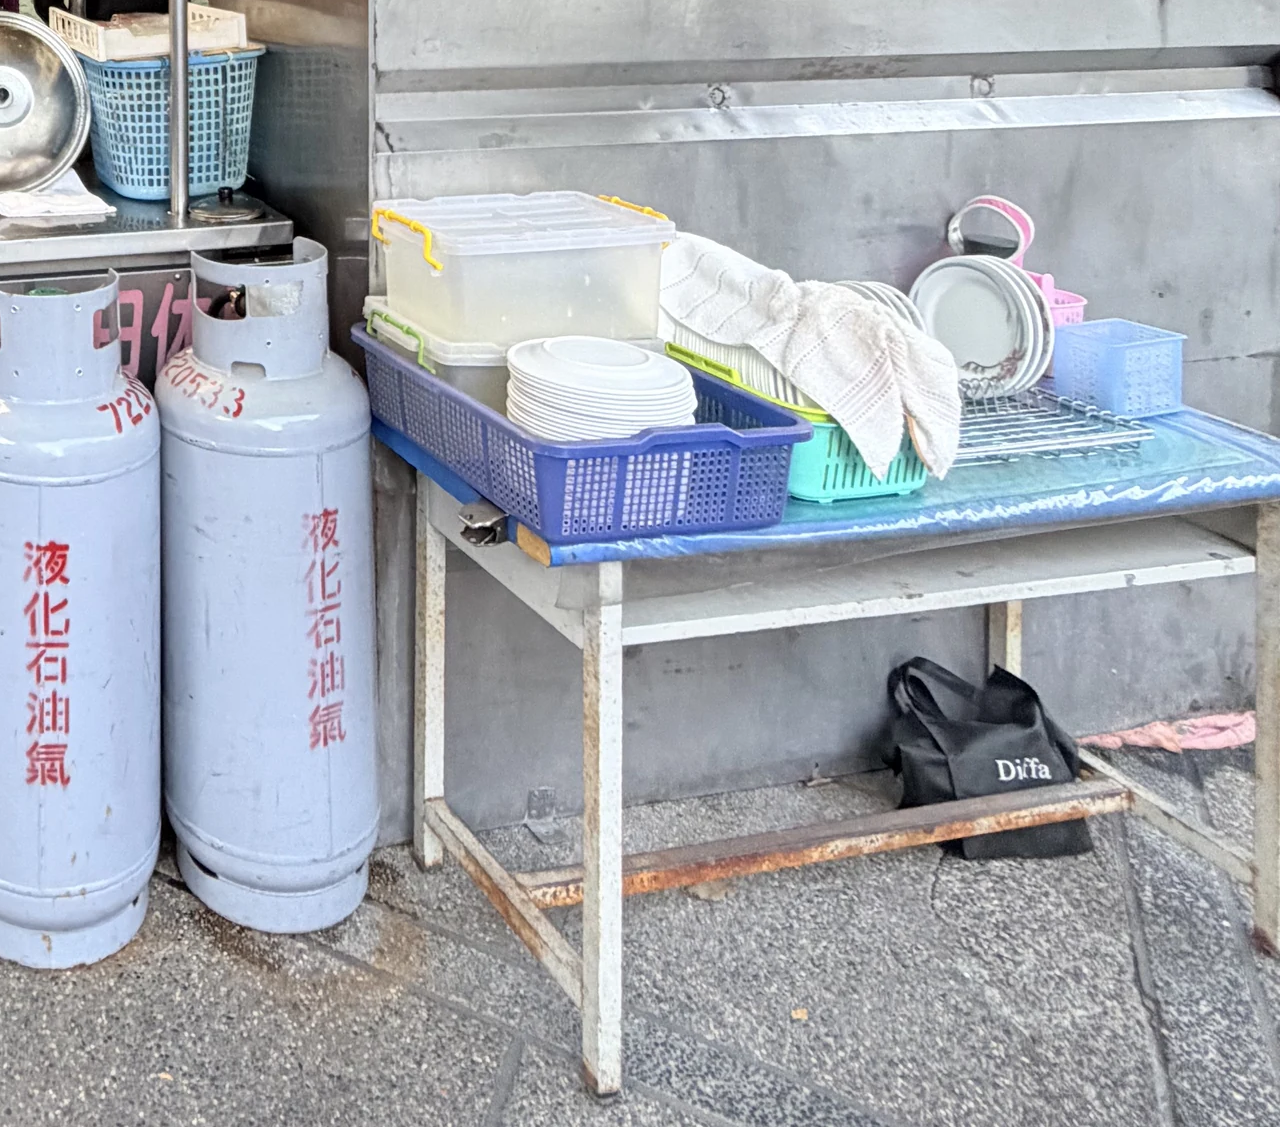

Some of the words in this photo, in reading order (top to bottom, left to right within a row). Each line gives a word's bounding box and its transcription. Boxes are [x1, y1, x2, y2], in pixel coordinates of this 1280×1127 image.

[23, 539, 71, 789] 液化石油氣
[301, 507, 348, 751] 液化石油氣
[994, 757, 1053, 782] Diffa
